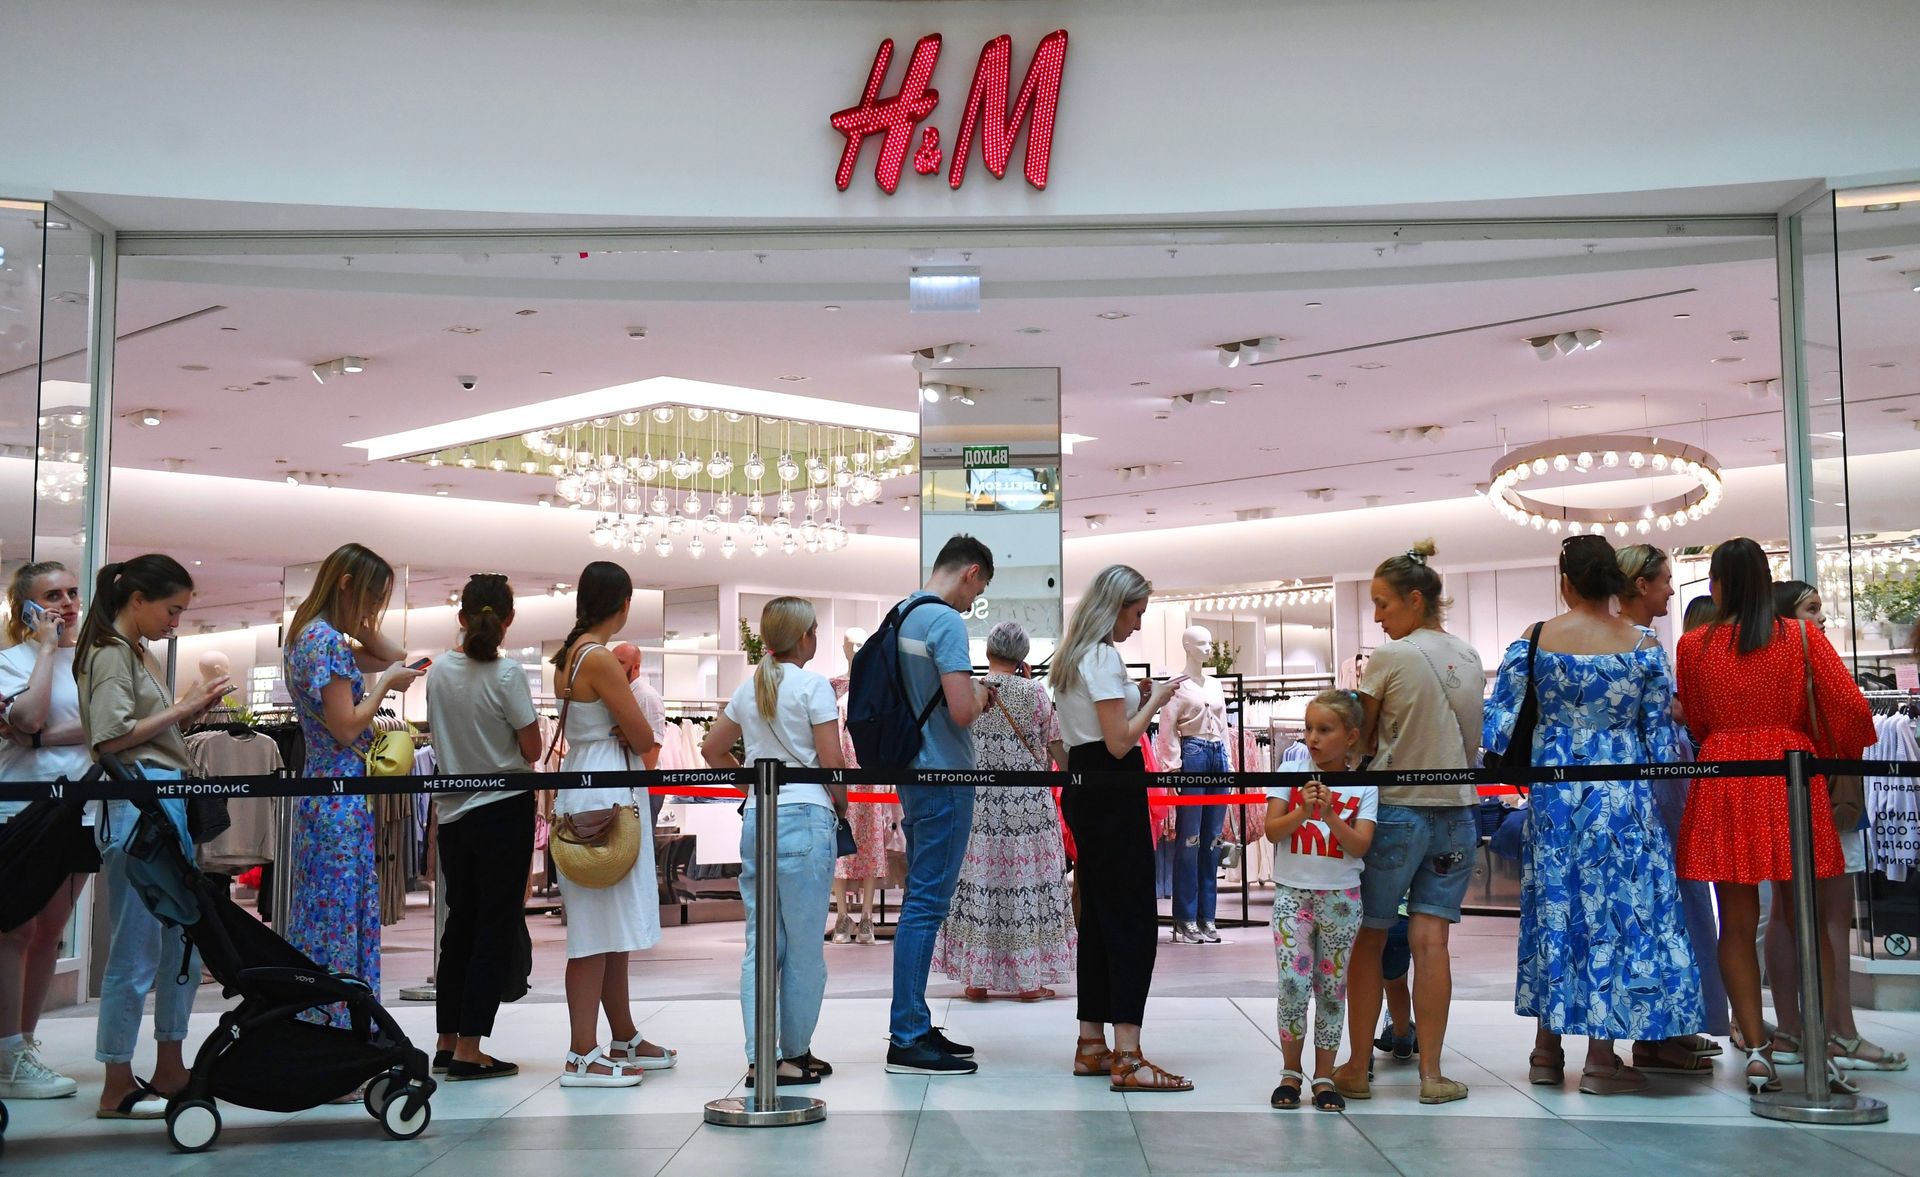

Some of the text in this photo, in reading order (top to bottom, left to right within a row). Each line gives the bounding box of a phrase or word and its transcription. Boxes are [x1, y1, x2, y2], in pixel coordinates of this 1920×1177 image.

[830, 29, 1068, 195] H&M
[156, 783, 250, 795] МЕТРОПОЛИС
[423, 777, 506, 789] МЕТРОПОЛИС
[662, 772, 736, 783] МЕТРОПОЛИС
[917, 773, 996, 783] МЕТРОПОЛИС
[1156, 775, 1235, 784] МЕТРОПОЛИС
[1396, 771, 1475, 782] МЕТРОПОЛИС
[1640, 765, 1719, 776] МЕТРОПОЛИС
[1875, 811, 1920, 822] ЮРИД
[1876, 825, 1908, 836] ООО
